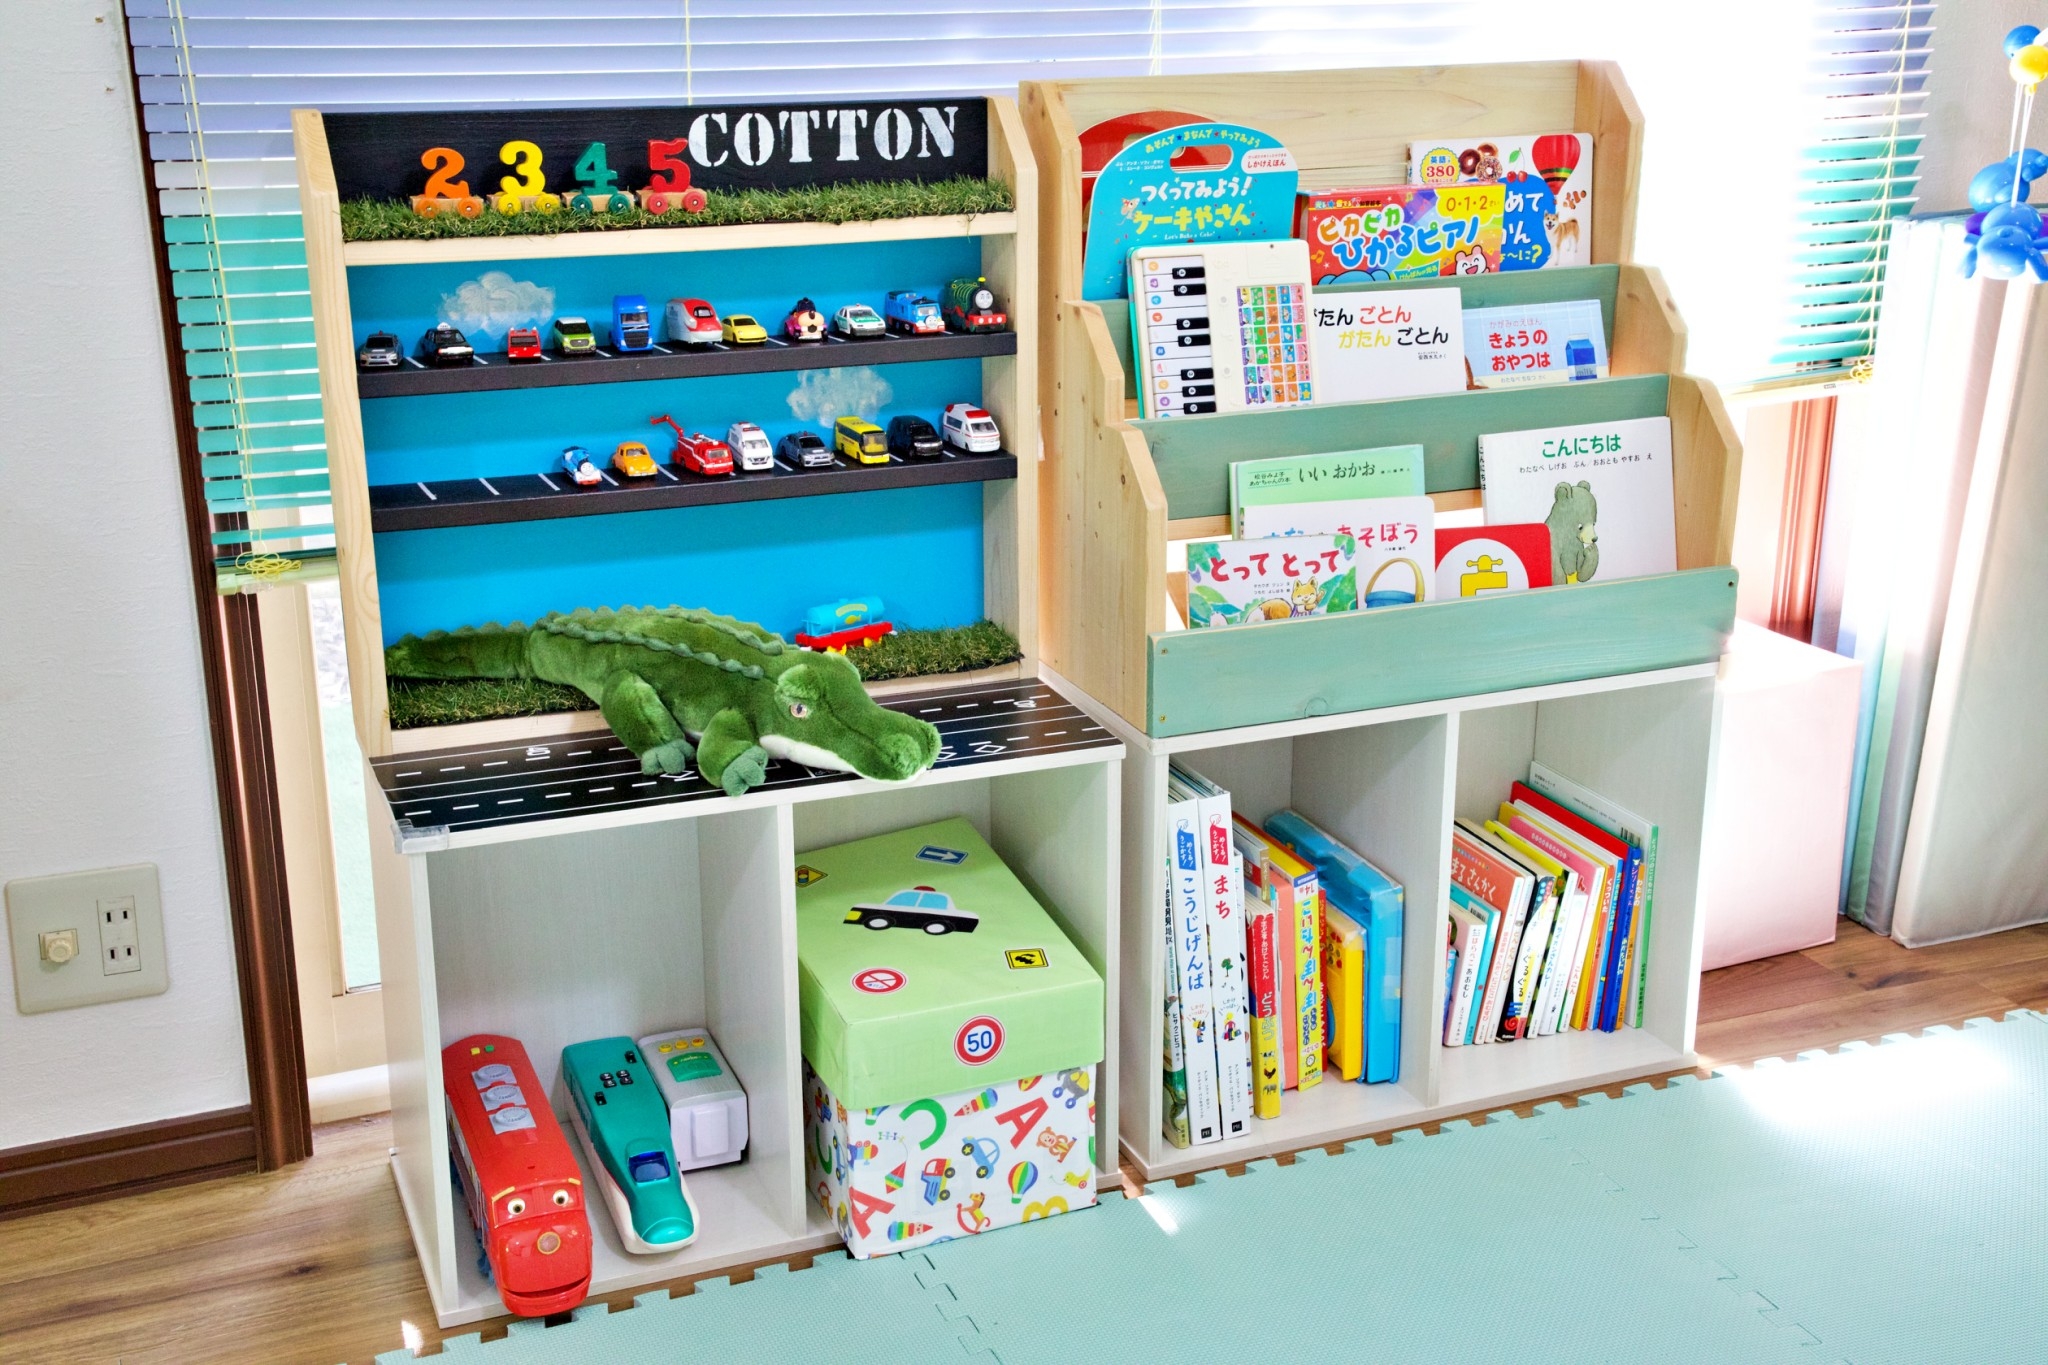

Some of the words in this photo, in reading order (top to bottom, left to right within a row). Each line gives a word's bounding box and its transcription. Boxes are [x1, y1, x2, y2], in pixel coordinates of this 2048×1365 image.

[688, 106, 958, 167] COTTON
[1145, 134, 1176, 154] あそんで
[1183, 129, 1213, 141] まなんで
[1220, 129, 1261, 148] やってみよう
[421, 147, 470, 199] 2
[500, 140, 546, 196] 3
[574, 141, 618, 196] 4
[647, 137, 691, 193] 5
[1247, 159, 1287, 169] しかけえほん
[1426, 165, 1455, 177] 380
[1141, 175, 1253, 202] つくってみよう!
[1133, 203, 1251, 235] ケーキやさん
[1319, 207, 1401, 244] ピカピカ
[1179, 232, 1194, 240] Bake
[1333, 216, 1479, 268] ひかるピアノ
[1314, 308, 1354, 327] たん
[1360, 305, 1411, 325] ごとん
[1489, 318, 1542, 329] かがみのえほん
[1338, 330, 1391, 349] がたん
[1398, 326, 1449, 346] ごとん
[1489, 329, 1548, 349] きょうの
[1491, 352, 1551, 372] おやつは
[1576, 367, 1594, 376] milk
[1542, 433, 1622, 458] こんにちは
[1299, 467, 1327, 482] いい
[1333, 461, 1376, 479] おかお
[1548, 462, 1567, 471] しげお
[1593, 458, 1619, 467] おおとも
[1621, 454, 1640, 463] やすお
[1646, 452, 1653, 460] え
[1249, 477, 1292, 486] あかちゃんの本
[1210, 553, 1270, 582] とって
[1282, 550, 1340, 577] とって
[1214, 874, 1231, 919] まち
[1602, 878, 1612, 913] くっついた
[1633, 879, 1643, 907] わたしの
[1182, 877, 1205, 990] こうじげんば
[1517, 954, 1529, 998] ぐるぐる
[1261, 991, 1275, 1040] どうぶつ
[967, 1030, 992, 1052] 50
[994, 1096, 1049, 1149] A
